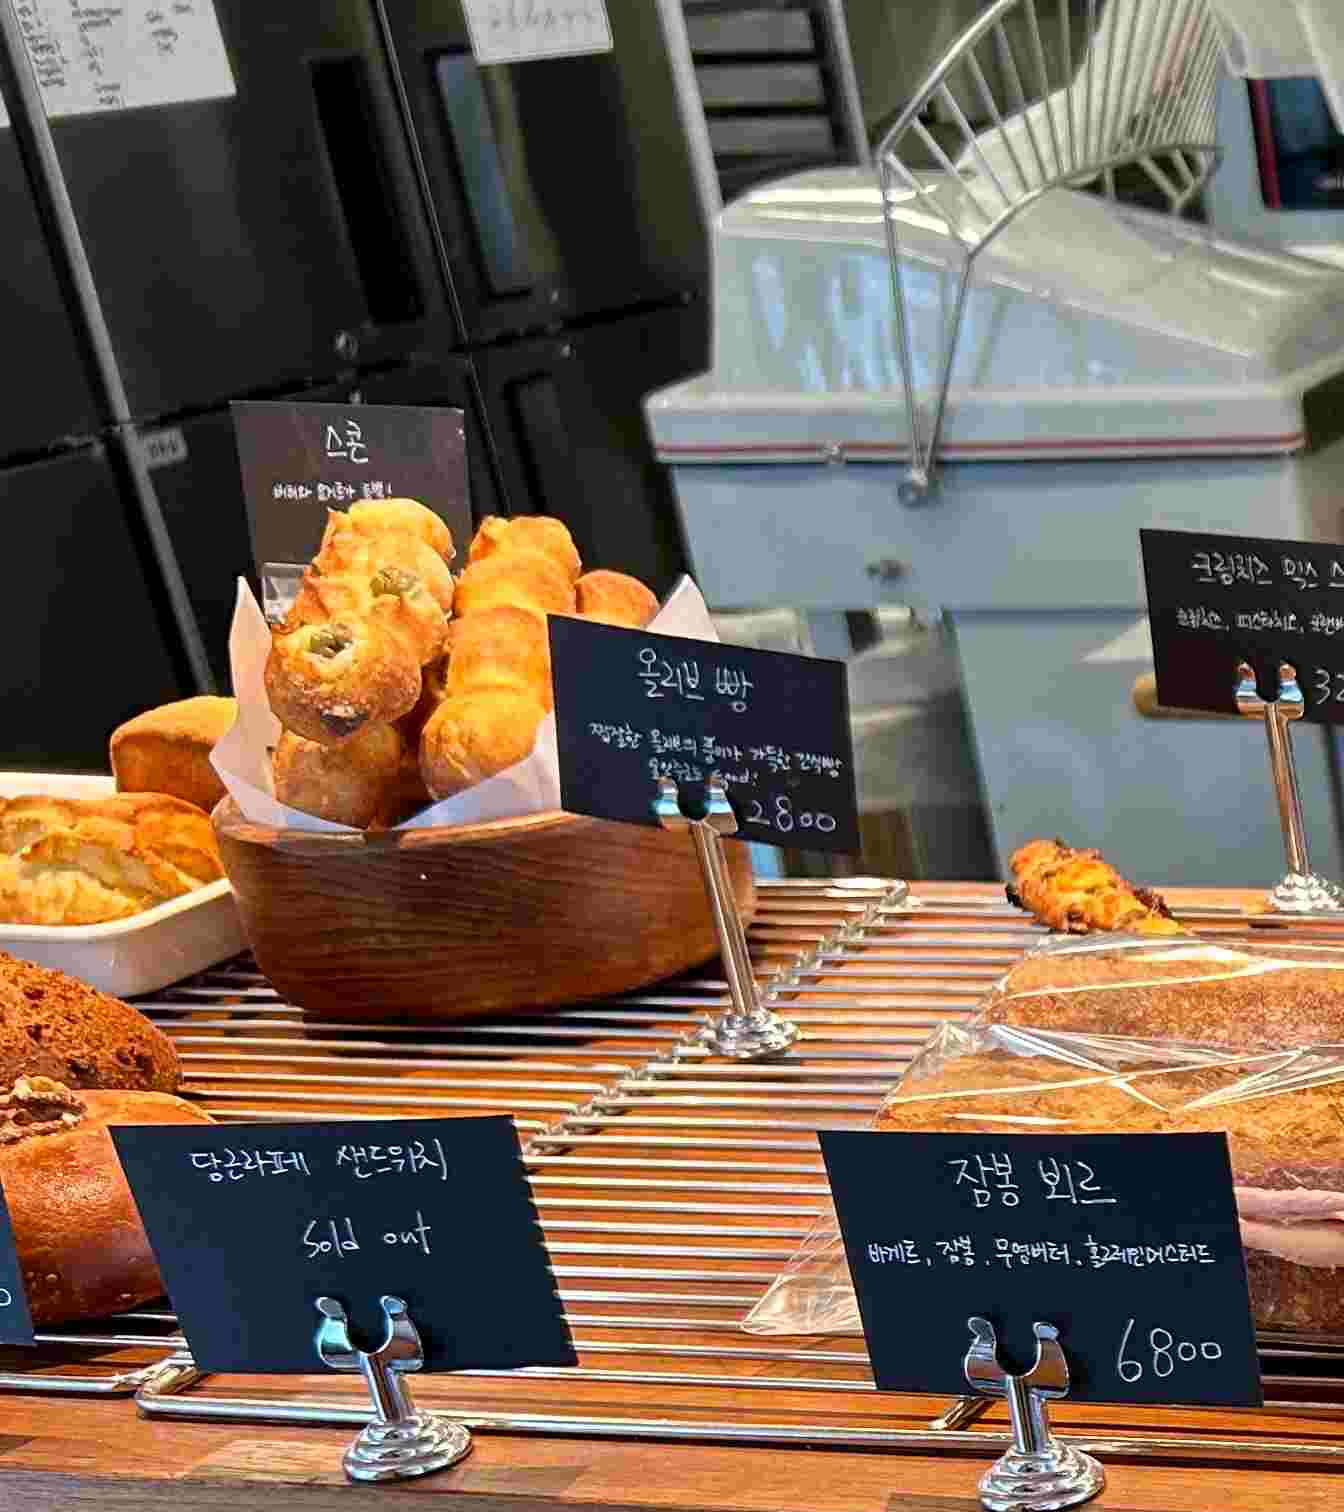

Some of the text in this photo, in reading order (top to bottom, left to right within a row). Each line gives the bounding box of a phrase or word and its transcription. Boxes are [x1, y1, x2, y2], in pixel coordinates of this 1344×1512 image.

[325, 420, 369, 465] 스콘
[1191, 551, 1273, 585] 크림치즈
[1283, 558, 1318, 590] 믹스
[638, 647, 754, 713] 올리브 빵
[650, 728, 697, 757] 올리브의
[746, 795, 837, 833] 2800
[189, 1138, 448, 1182] 당근라페 샌드위치
[948, 1152, 1117, 1208] 잠봉 뵈르
[303, 1211, 432, 1259] Sold out
[1117, 1318, 1222, 1383] 6800
